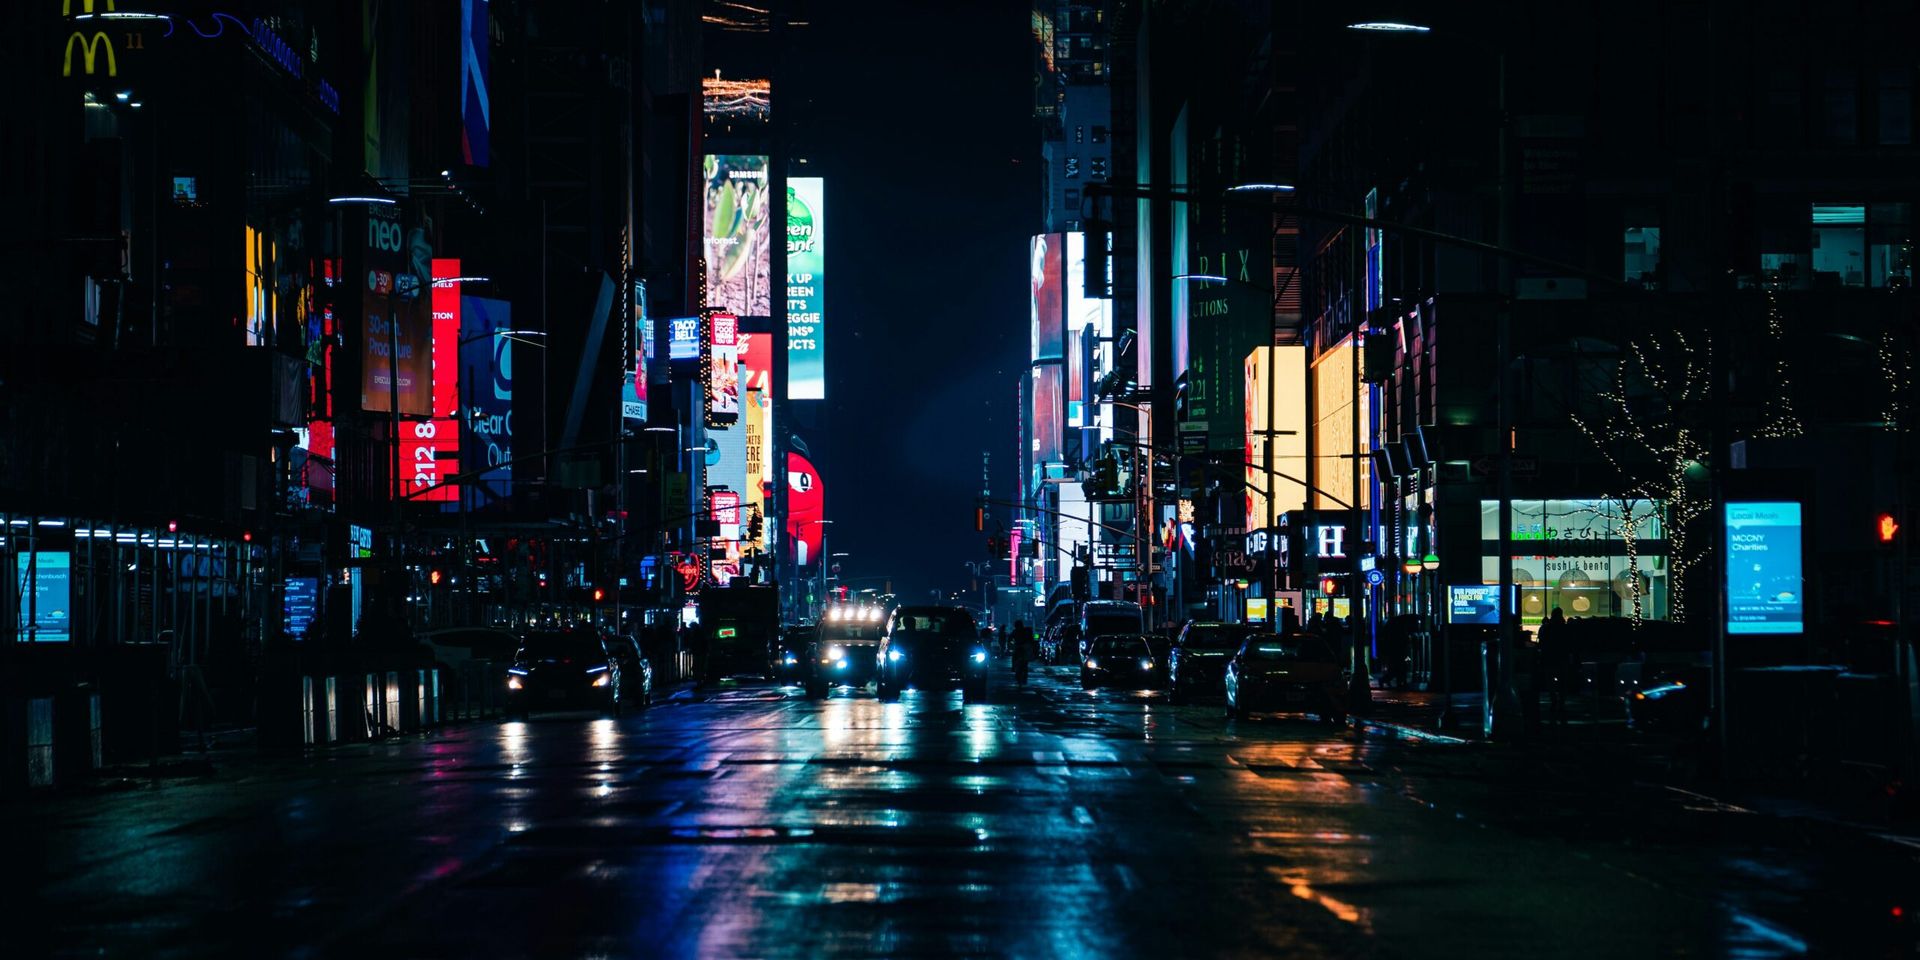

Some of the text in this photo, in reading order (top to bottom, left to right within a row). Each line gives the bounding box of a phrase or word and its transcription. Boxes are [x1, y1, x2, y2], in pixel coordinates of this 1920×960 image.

[368, 217, 402, 252] neo
[796, 273, 813, 284] UP
[673, 320, 696, 330] TACO
[675, 329, 697, 341] BELL
[1546, 560, 1570, 571] sushi
[1583, 560, 1609, 571] bento
